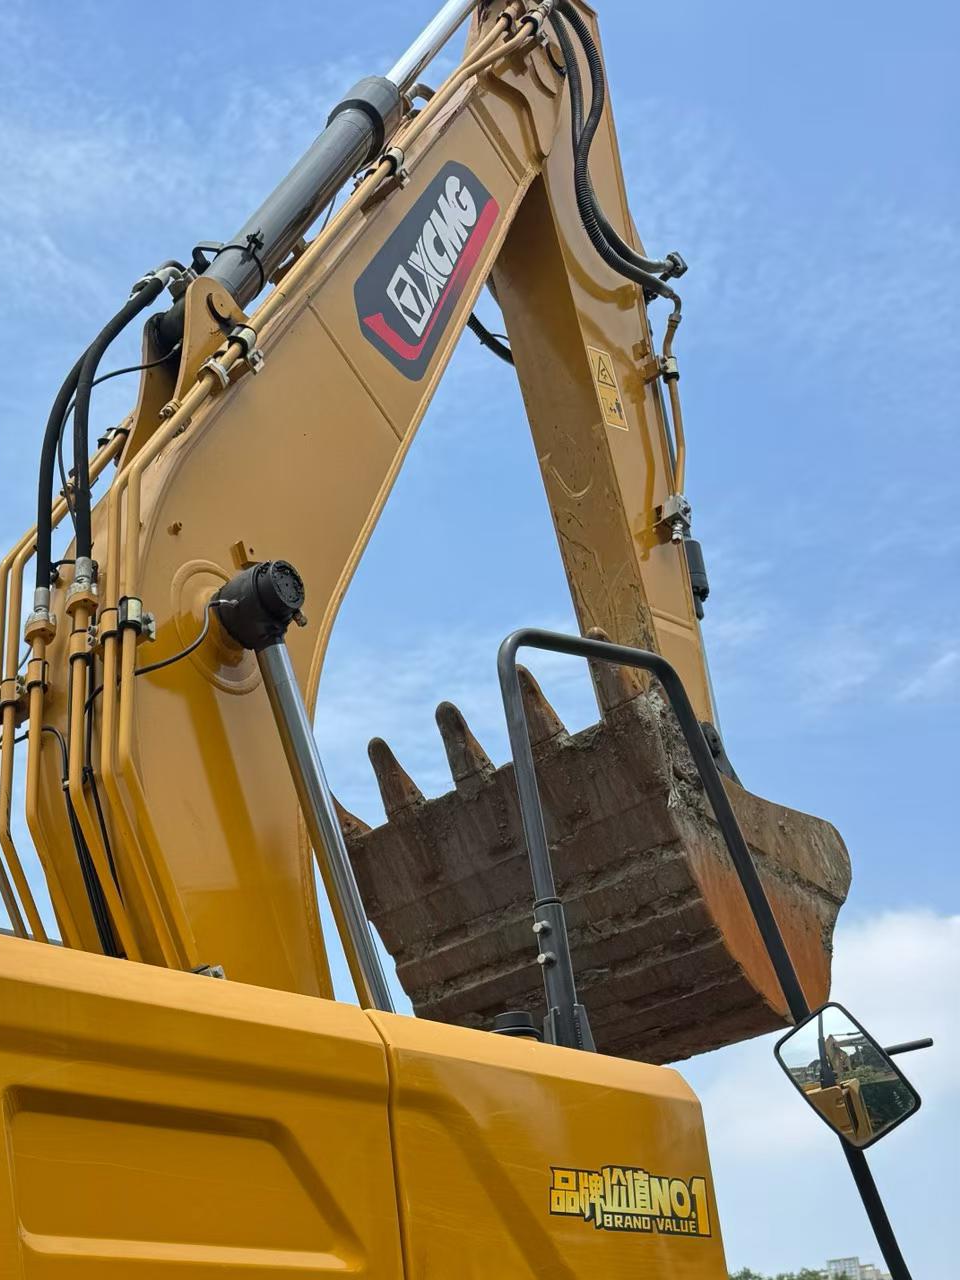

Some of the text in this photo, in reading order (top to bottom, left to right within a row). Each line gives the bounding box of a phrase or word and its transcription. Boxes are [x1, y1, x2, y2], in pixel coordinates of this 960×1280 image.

[407, 175, 478, 309] XCMG
[603, 1213, 698, 1234] BRAND VALUE
